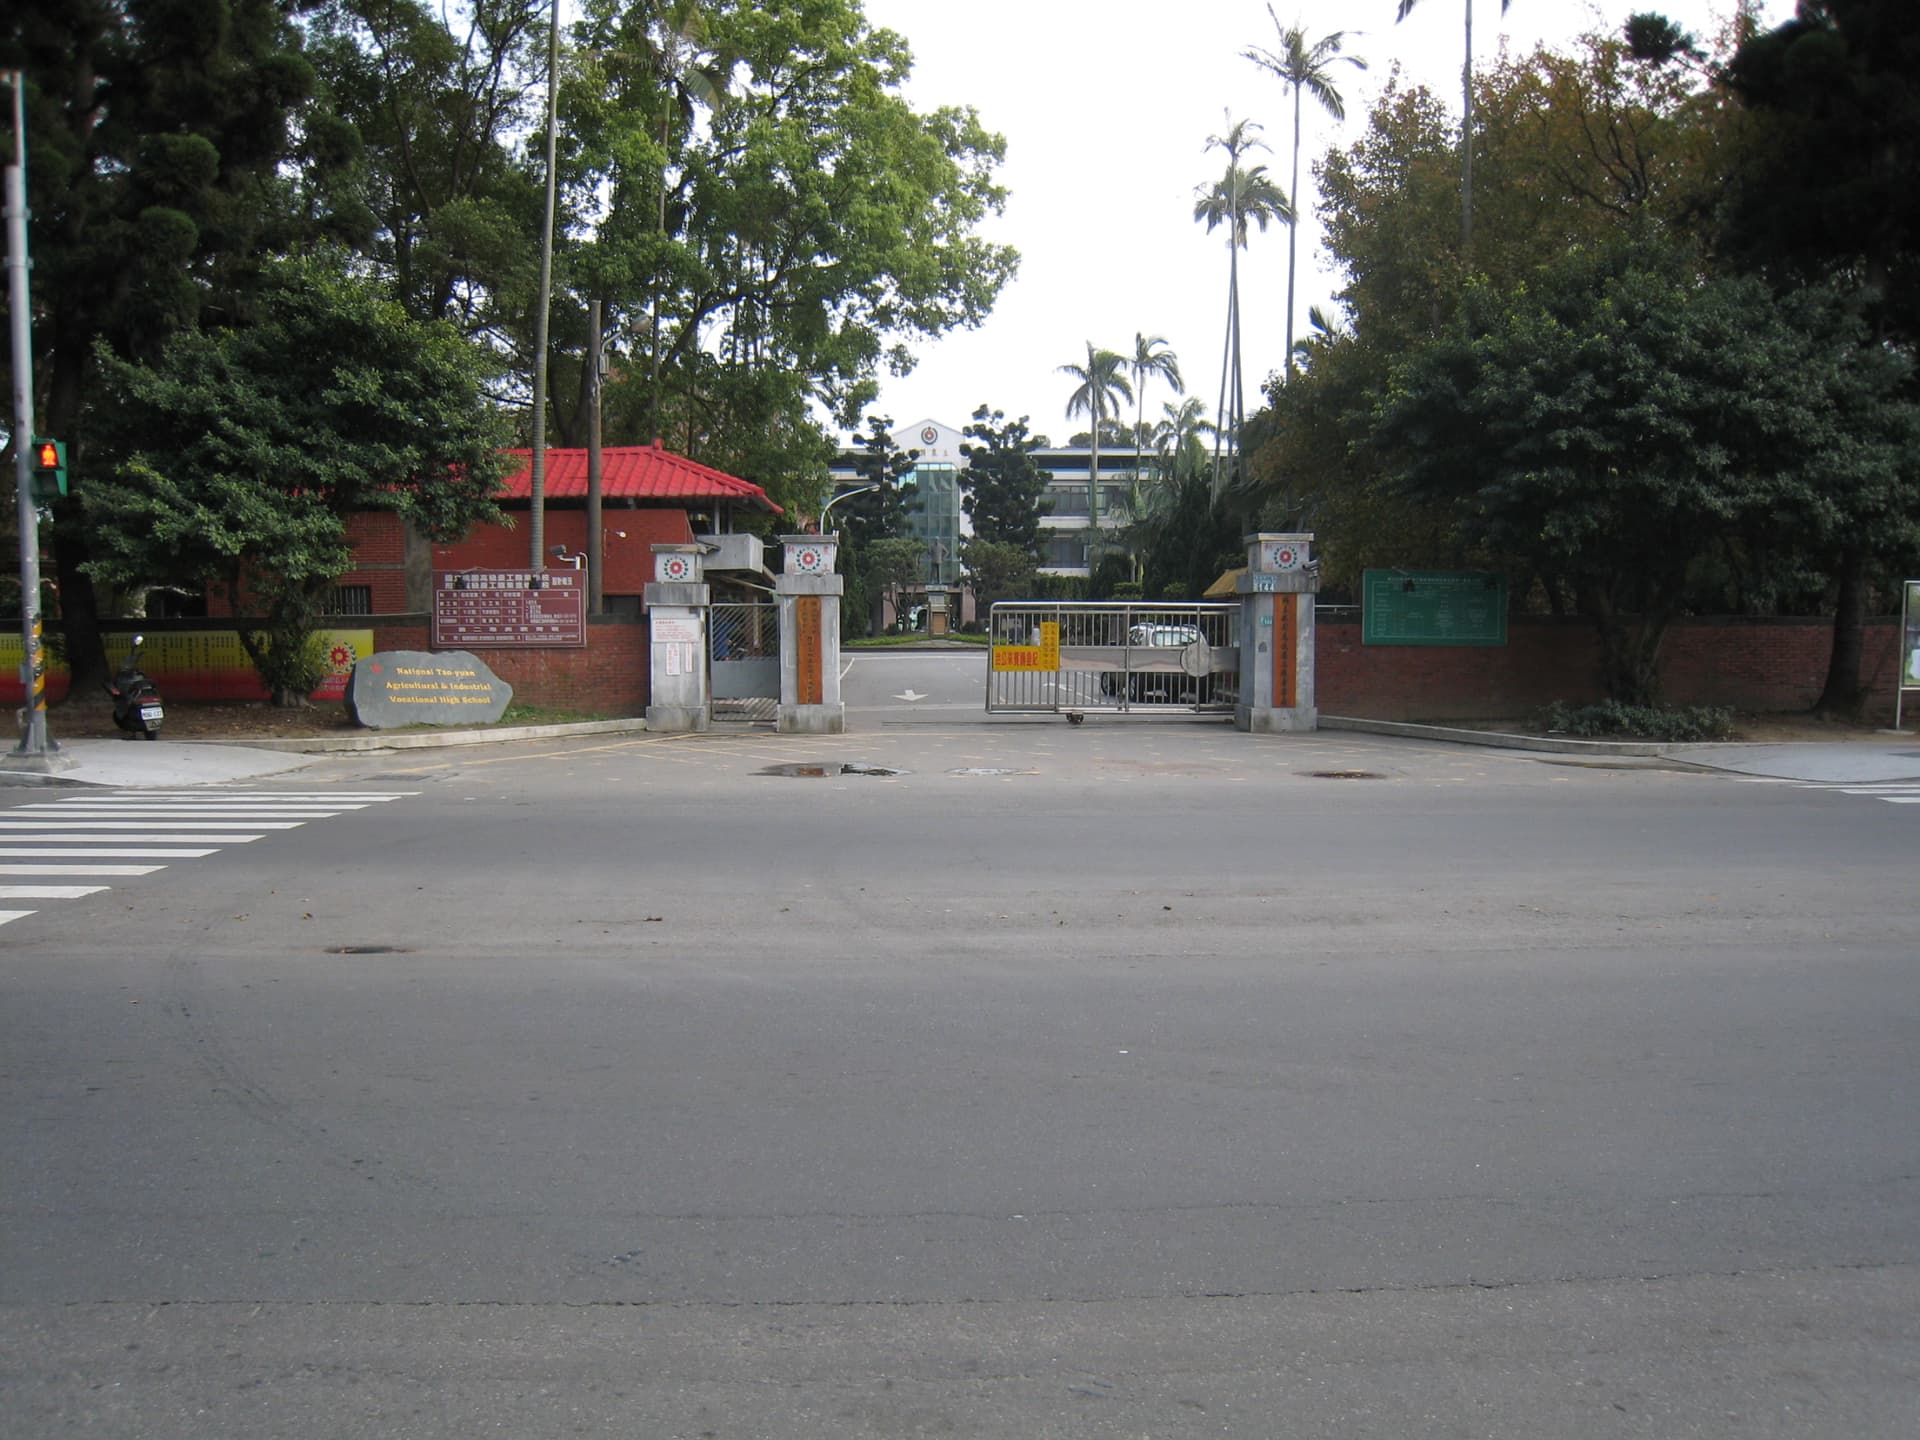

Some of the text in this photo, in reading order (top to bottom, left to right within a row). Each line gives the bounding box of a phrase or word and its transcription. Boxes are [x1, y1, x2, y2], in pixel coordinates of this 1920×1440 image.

[395, 667, 476, 677] National Tao-yuan
[386, 682, 439, 691] Agricultural
[389, 695, 491, 704] Vocational High School
